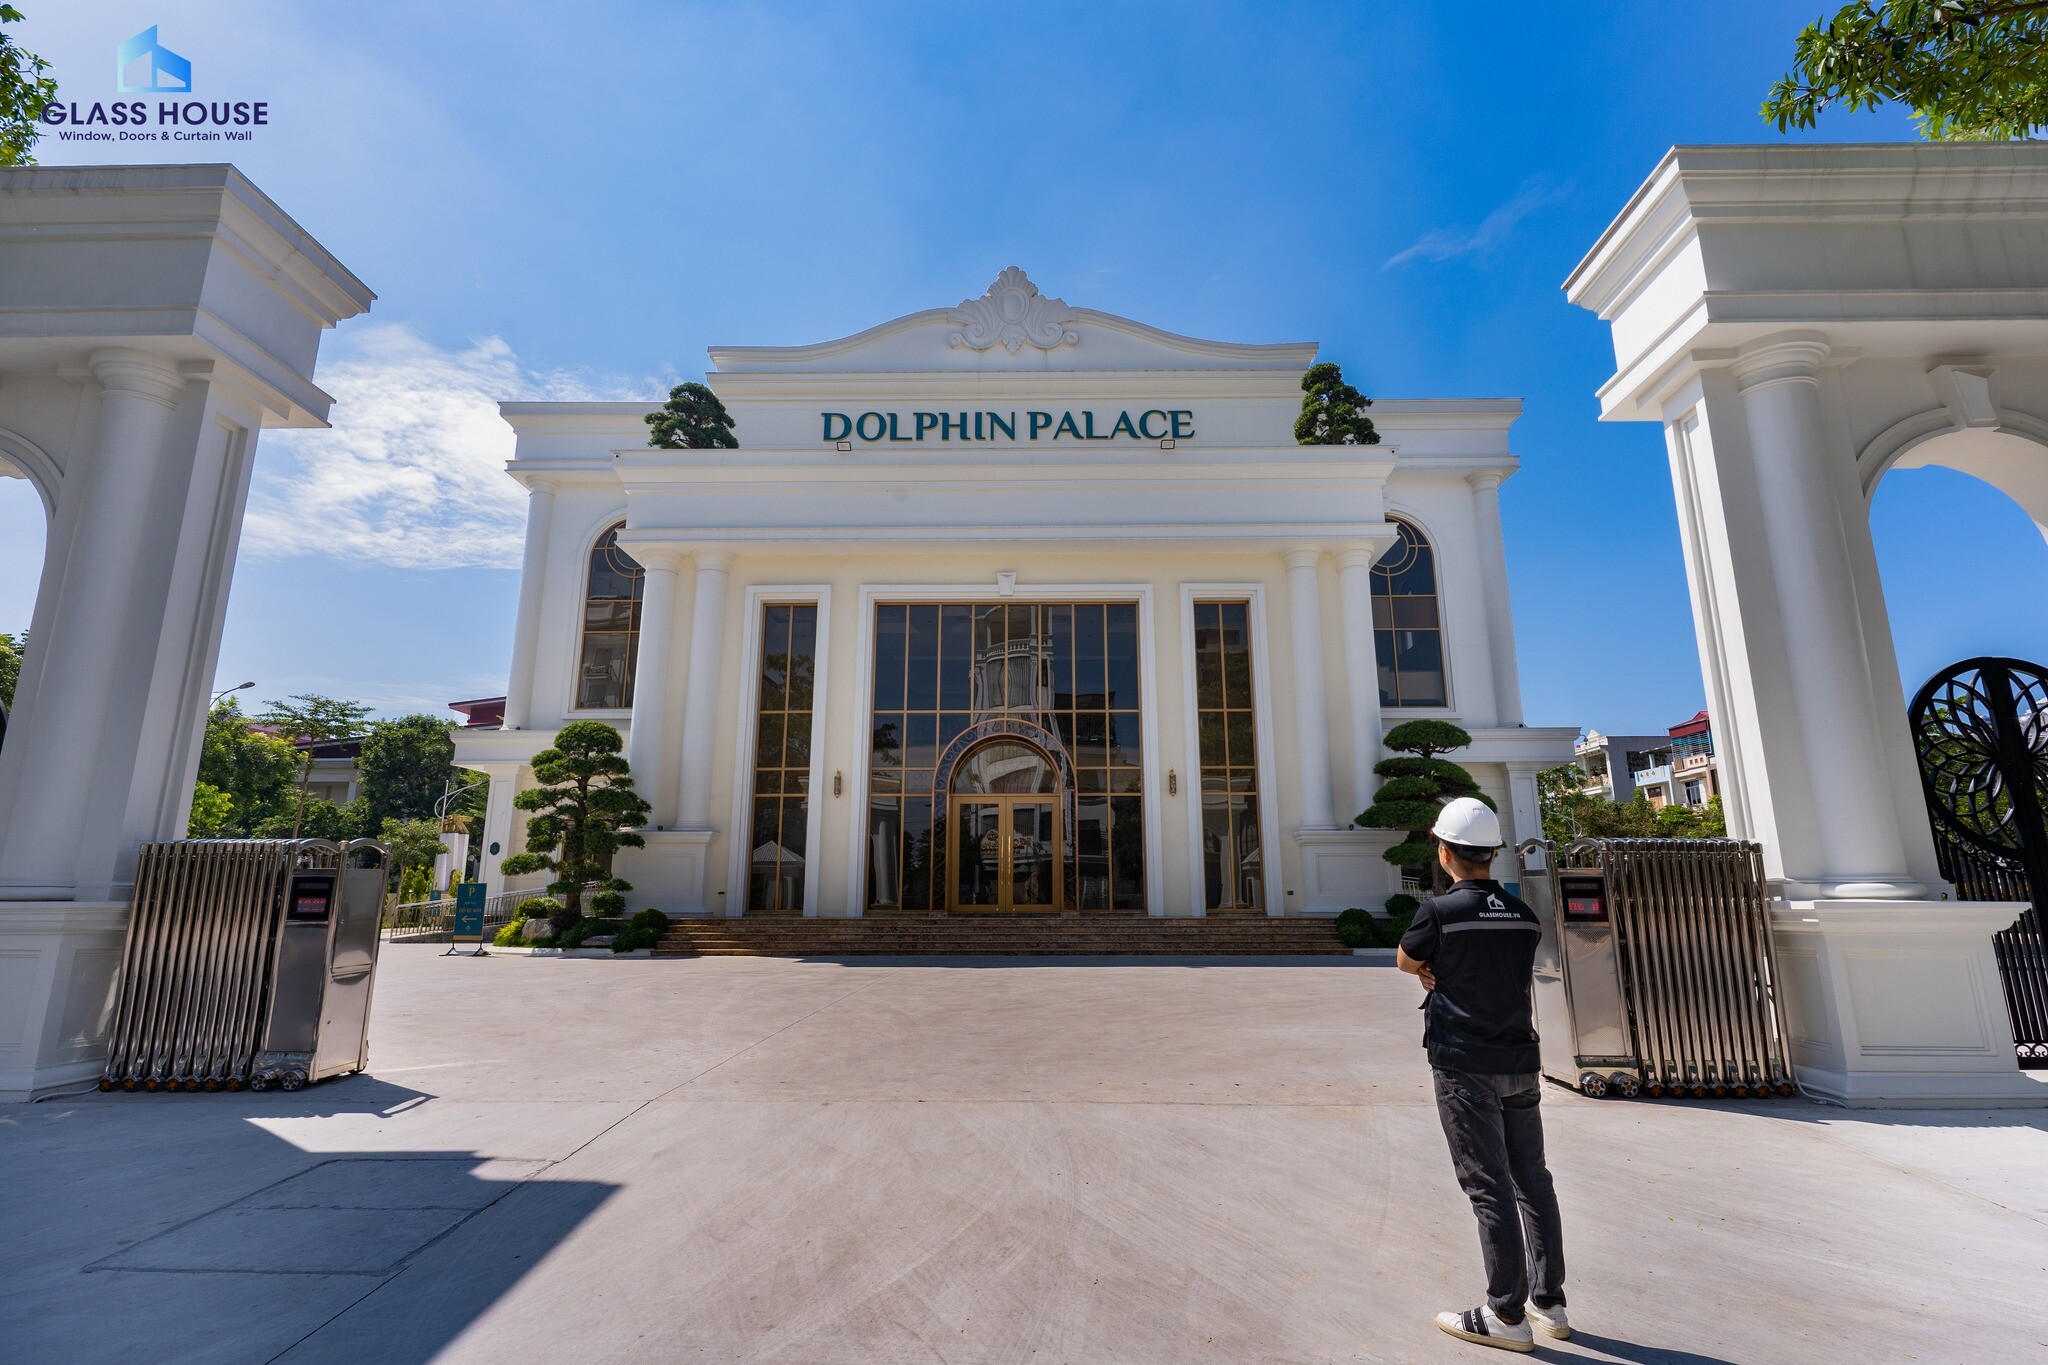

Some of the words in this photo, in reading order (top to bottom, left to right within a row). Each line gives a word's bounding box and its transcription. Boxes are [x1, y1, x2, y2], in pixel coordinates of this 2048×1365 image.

[821, 411, 1016, 441] DOLPHIN
[1027, 410, 1196, 440] PALACE
[469, 887, 475, 896] P
